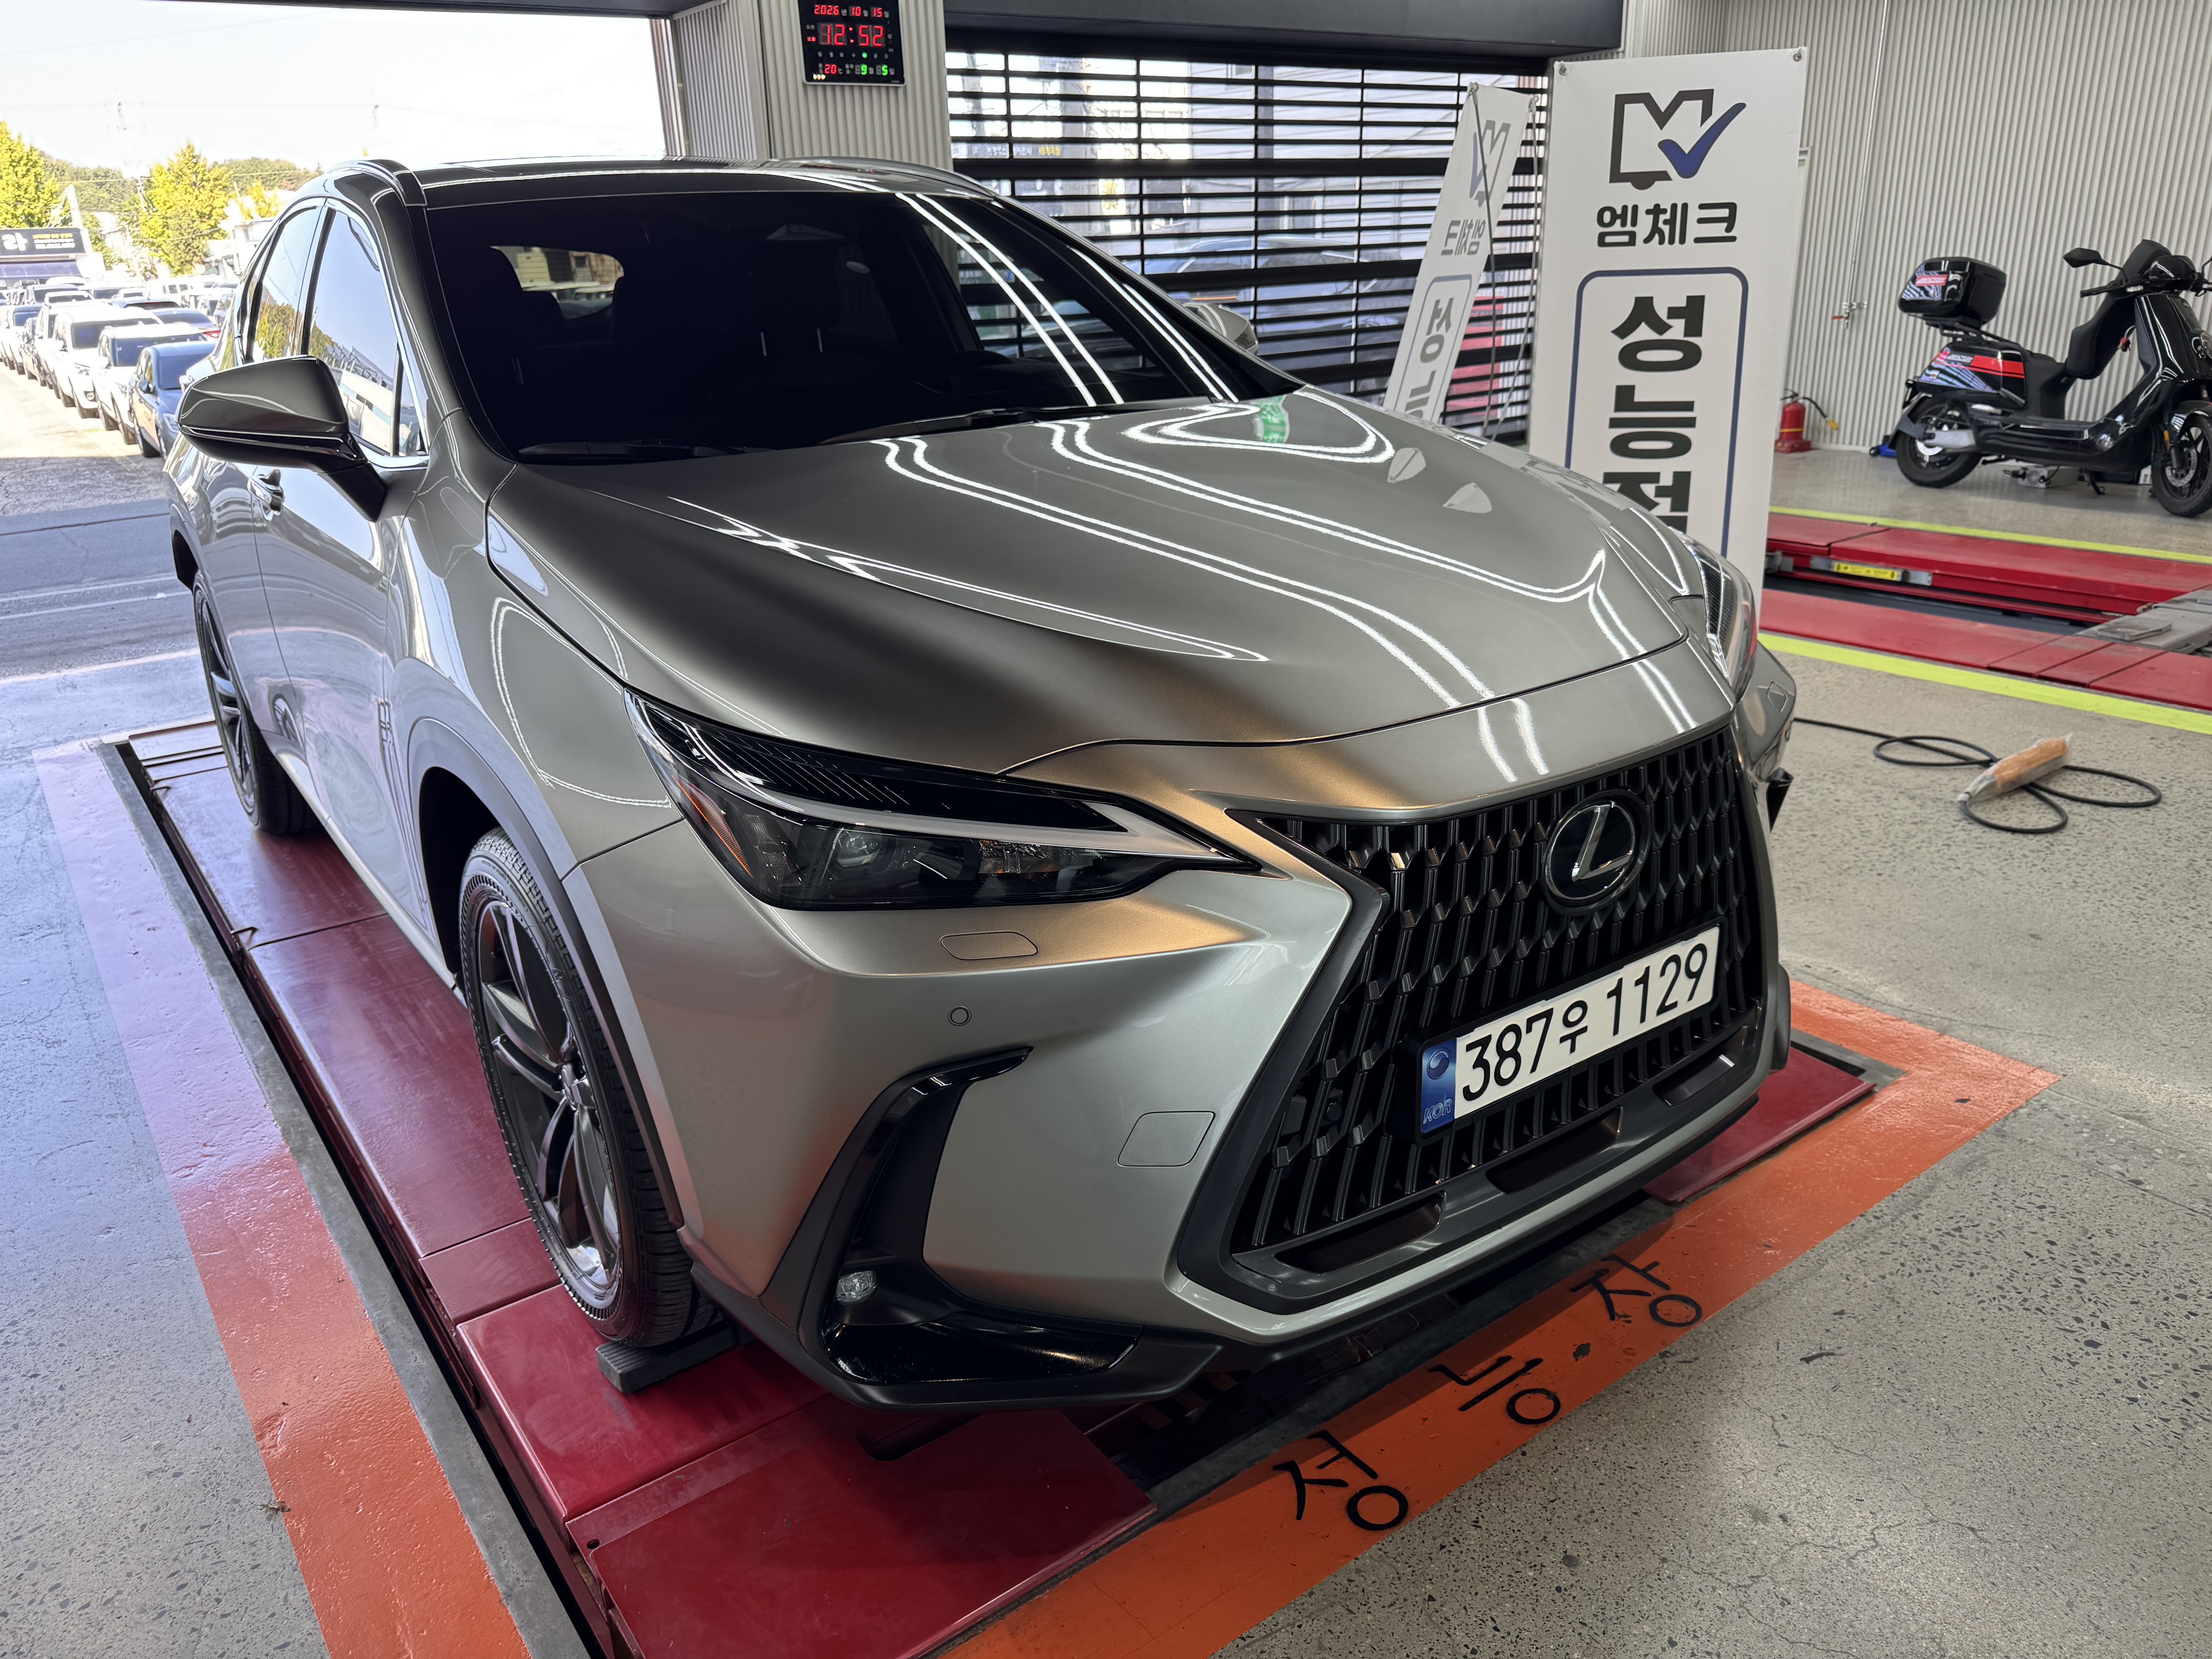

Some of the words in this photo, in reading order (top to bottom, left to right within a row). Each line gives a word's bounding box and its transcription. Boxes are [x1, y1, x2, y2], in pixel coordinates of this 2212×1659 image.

[826, 24, 884, 47] 12:52
[1596, 202, 1738, 248] 엠체크
[1462, 1000, 1588, 1101] 387우
[1607, 943, 1707, 1036] 1129
[1423, 1098, 1452, 1124] KOR
